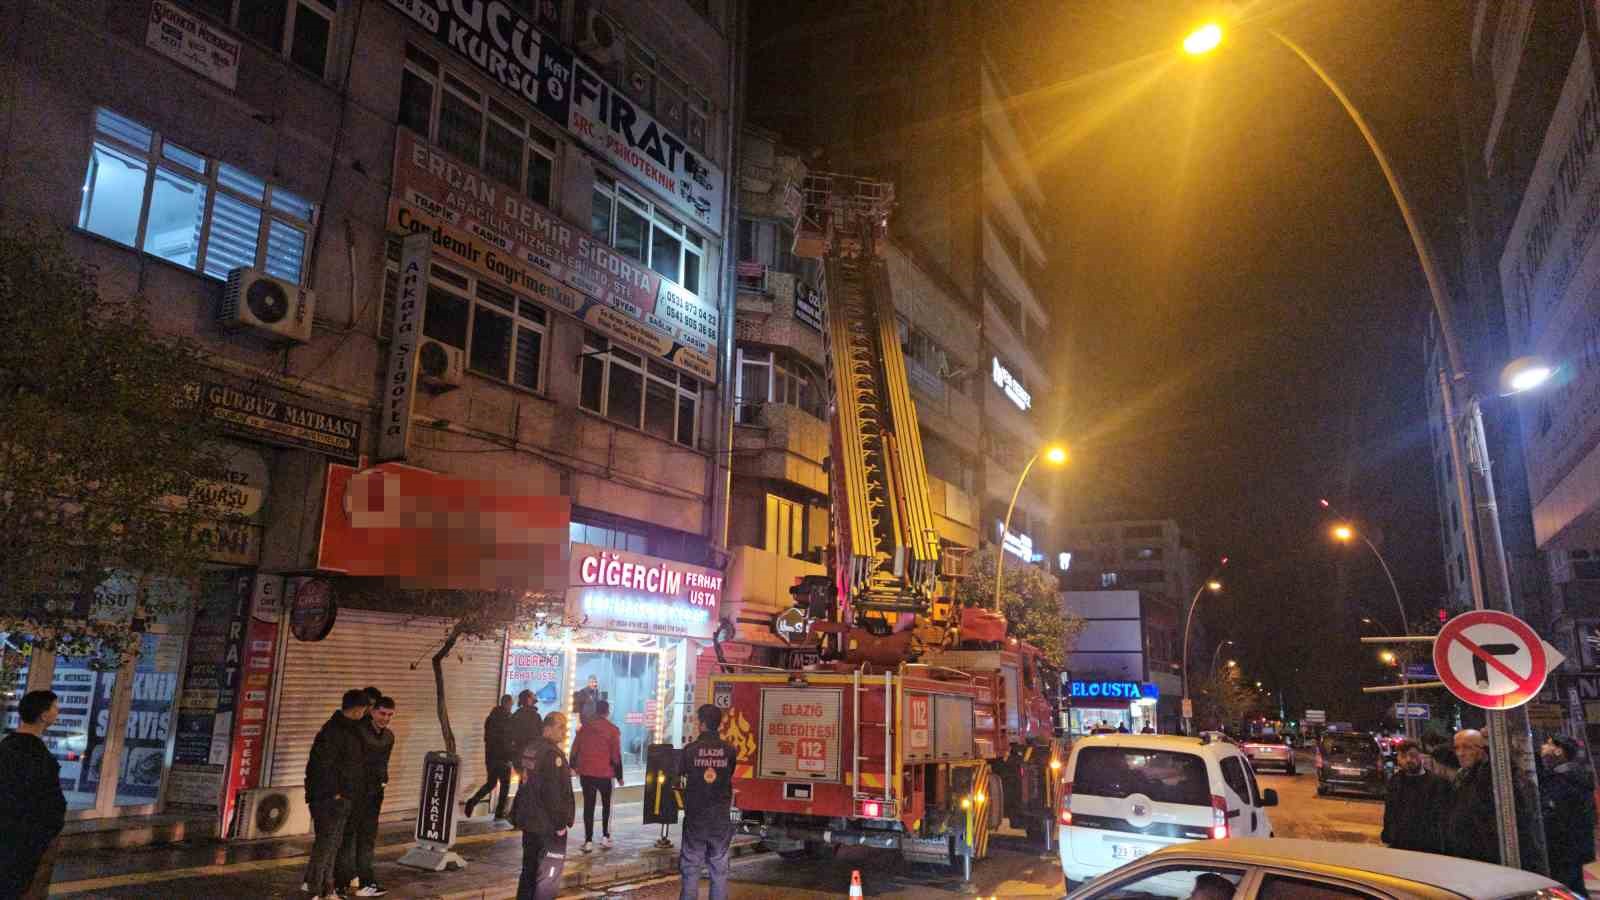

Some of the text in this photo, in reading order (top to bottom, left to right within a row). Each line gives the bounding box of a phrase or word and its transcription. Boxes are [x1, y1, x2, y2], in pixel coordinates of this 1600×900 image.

[449, 19, 540, 105] KURSU
[543, 53, 570, 84] KAT
[575, 77, 684, 172] FIRAT
[413, 144, 651, 293] ERCAN DEMİR SİGORTA
[386, 259, 420, 437] Ankara Sigorta
[284, 406, 359, 439] MATBAASI
[580, 551, 723, 595] CİĞERCİM FERHAT
[690, 590, 716, 608] USTA
[103, 672, 177, 704] TKNİK
[96, 710, 171, 741] SRVİS
[782, 703, 823, 717] ELAZIĞ
[912, 700, 926, 726] 112
[768, 720, 837, 738] BELEDİYESİ
[801, 741, 822, 758] 112
[427, 764, 444, 840] ANTİKACIM
